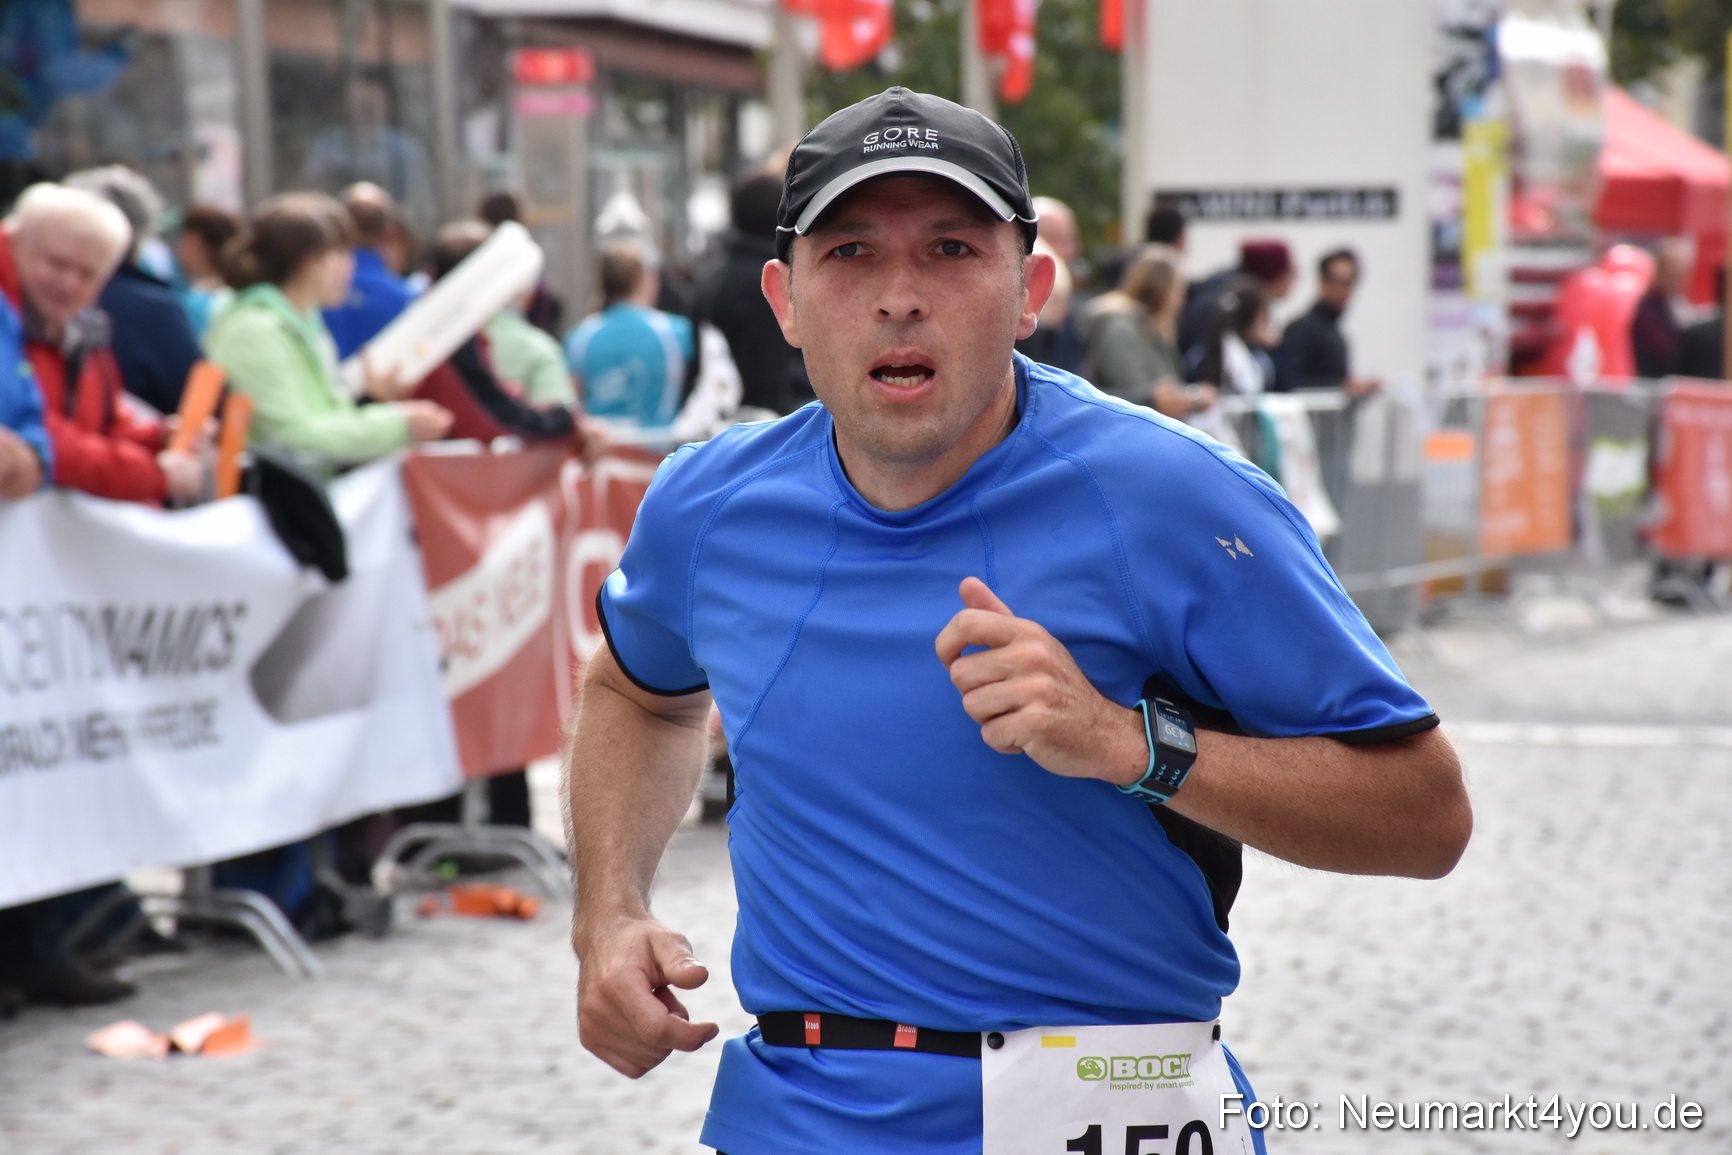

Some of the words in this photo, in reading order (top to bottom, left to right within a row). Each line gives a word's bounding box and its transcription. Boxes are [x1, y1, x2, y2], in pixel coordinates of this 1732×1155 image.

[863, 127, 939, 144] GORE
[863, 140, 907, 154] RUNNING
[908, 139, 939, 150] WEAR
[805, 1021, 820, 1030] Braun
[897, 1023, 917, 1034] Braun
[1110, 1054, 1192, 1081] BOCK
[1109, 1082, 1142, 1091] inspired
[1144, 1082, 1155, 1090] by
[1156, 1081, 1178, 1089] smart
